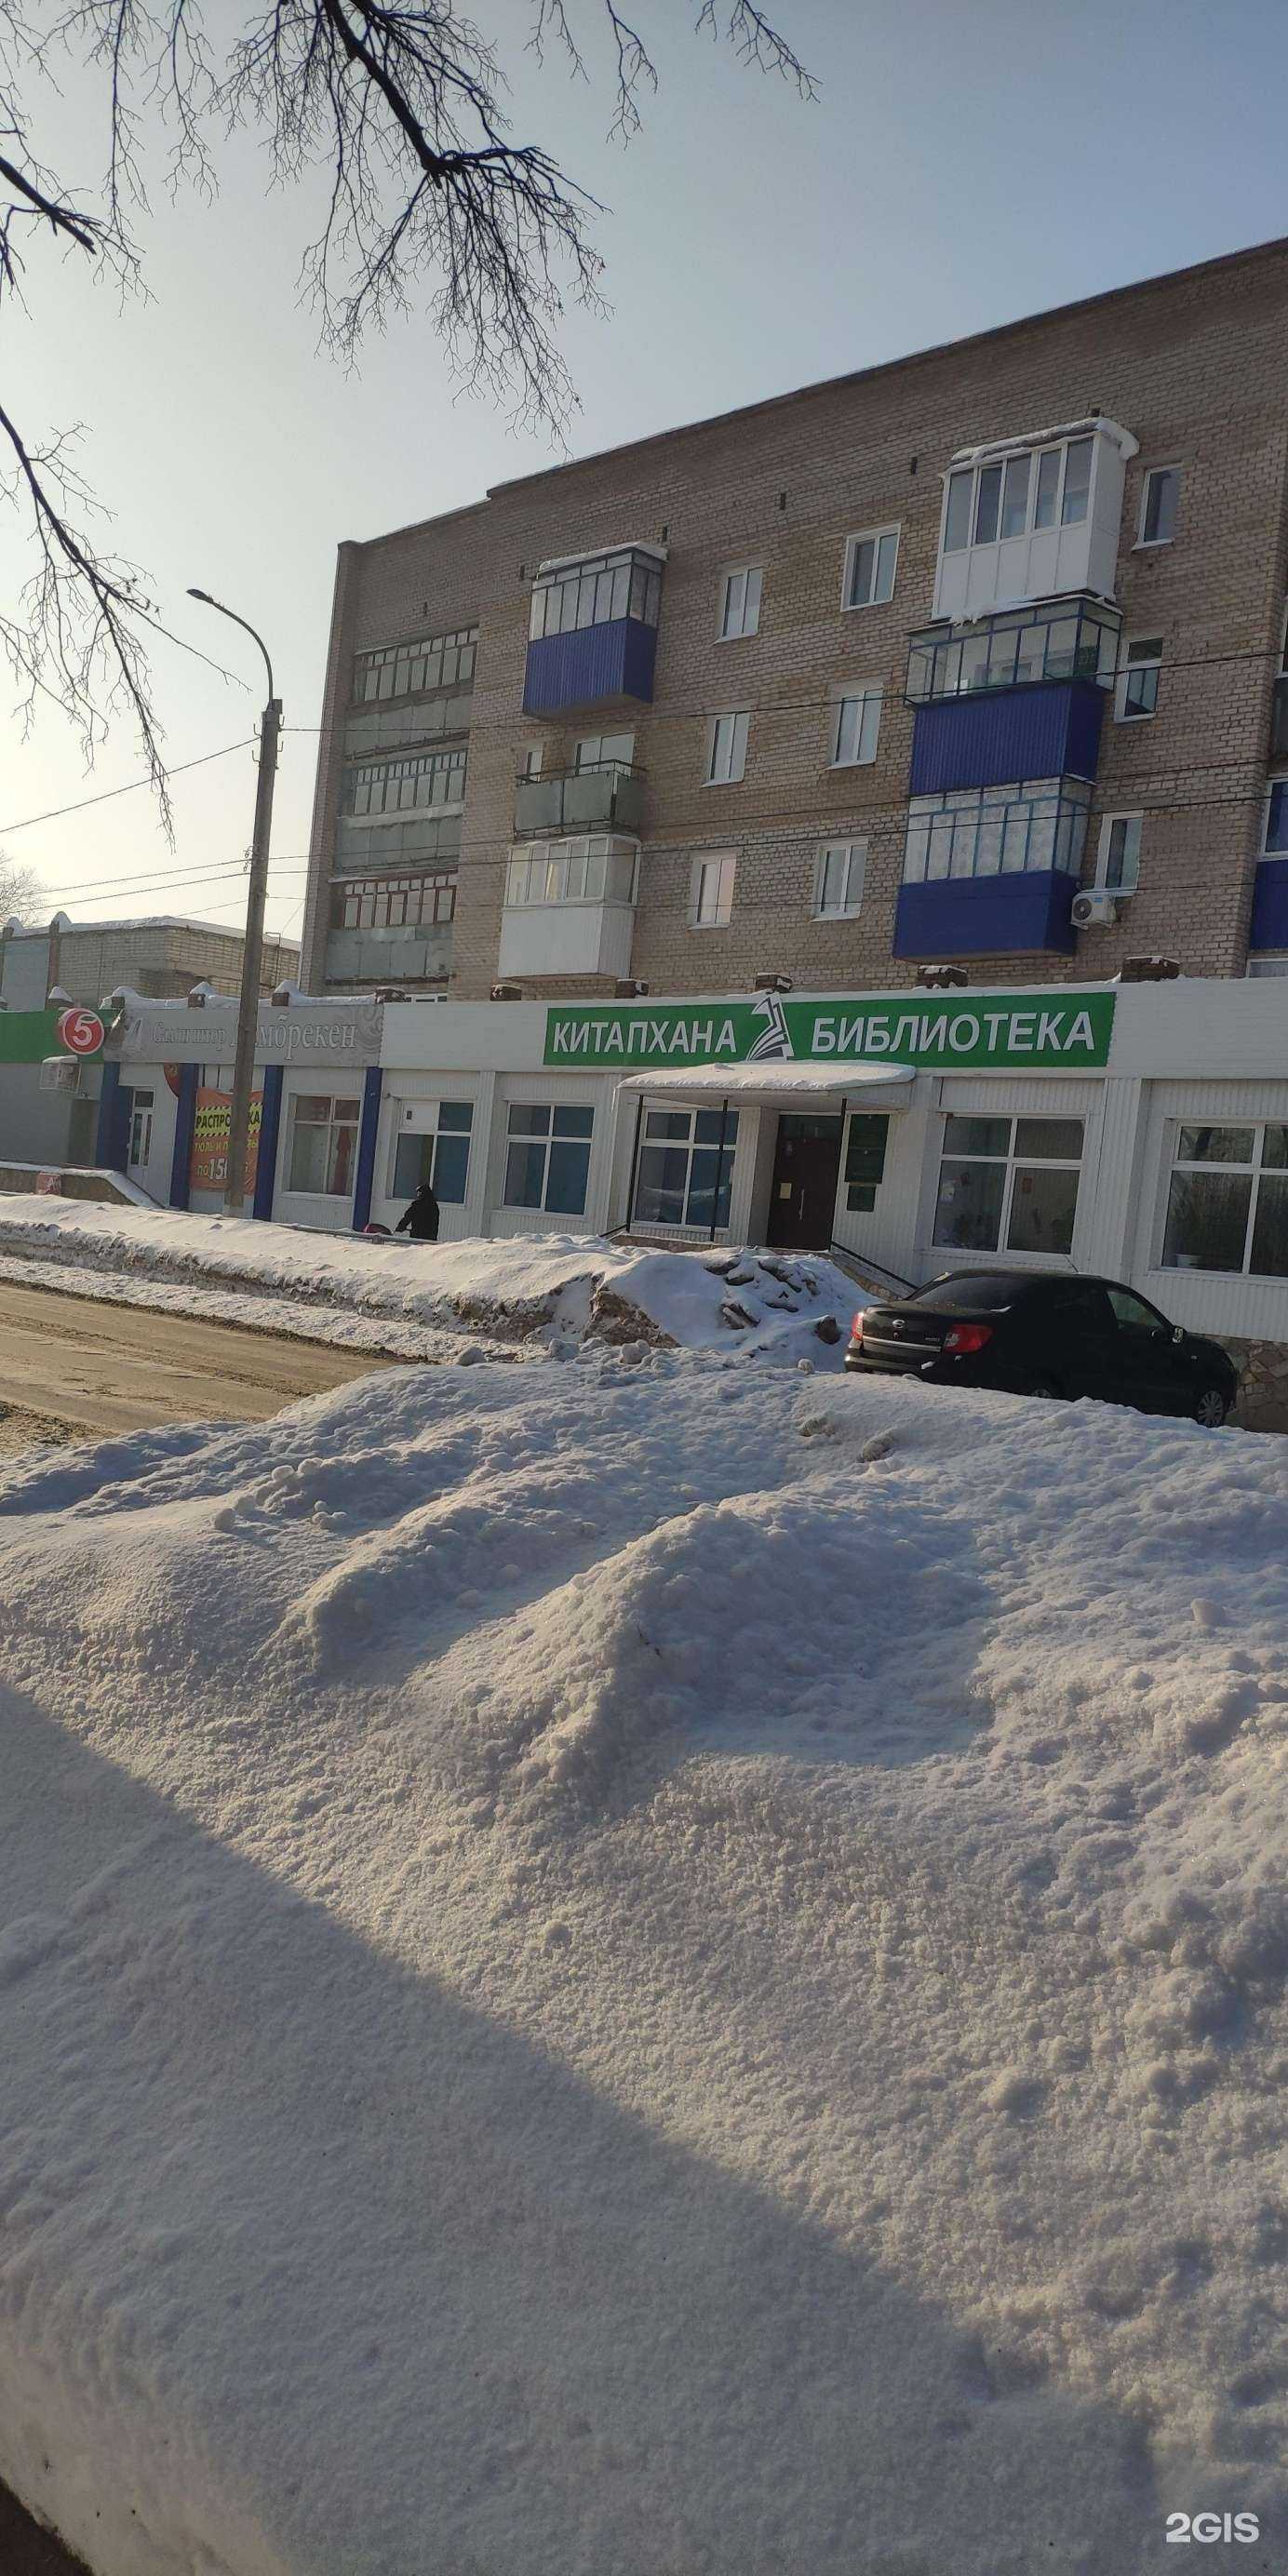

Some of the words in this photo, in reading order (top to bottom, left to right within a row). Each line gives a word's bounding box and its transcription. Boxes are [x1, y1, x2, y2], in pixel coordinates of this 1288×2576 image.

[73, 1014, 99, 1046] 5
[231, 1013, 358, 1061] мбрекен
[553, 1020, 737, 1053] КИТАПХАНА
[811, 1012, 1094, 1053] БИБЛИОТЕКА
[196, 1111, 261, 1129] РАСПРОА
